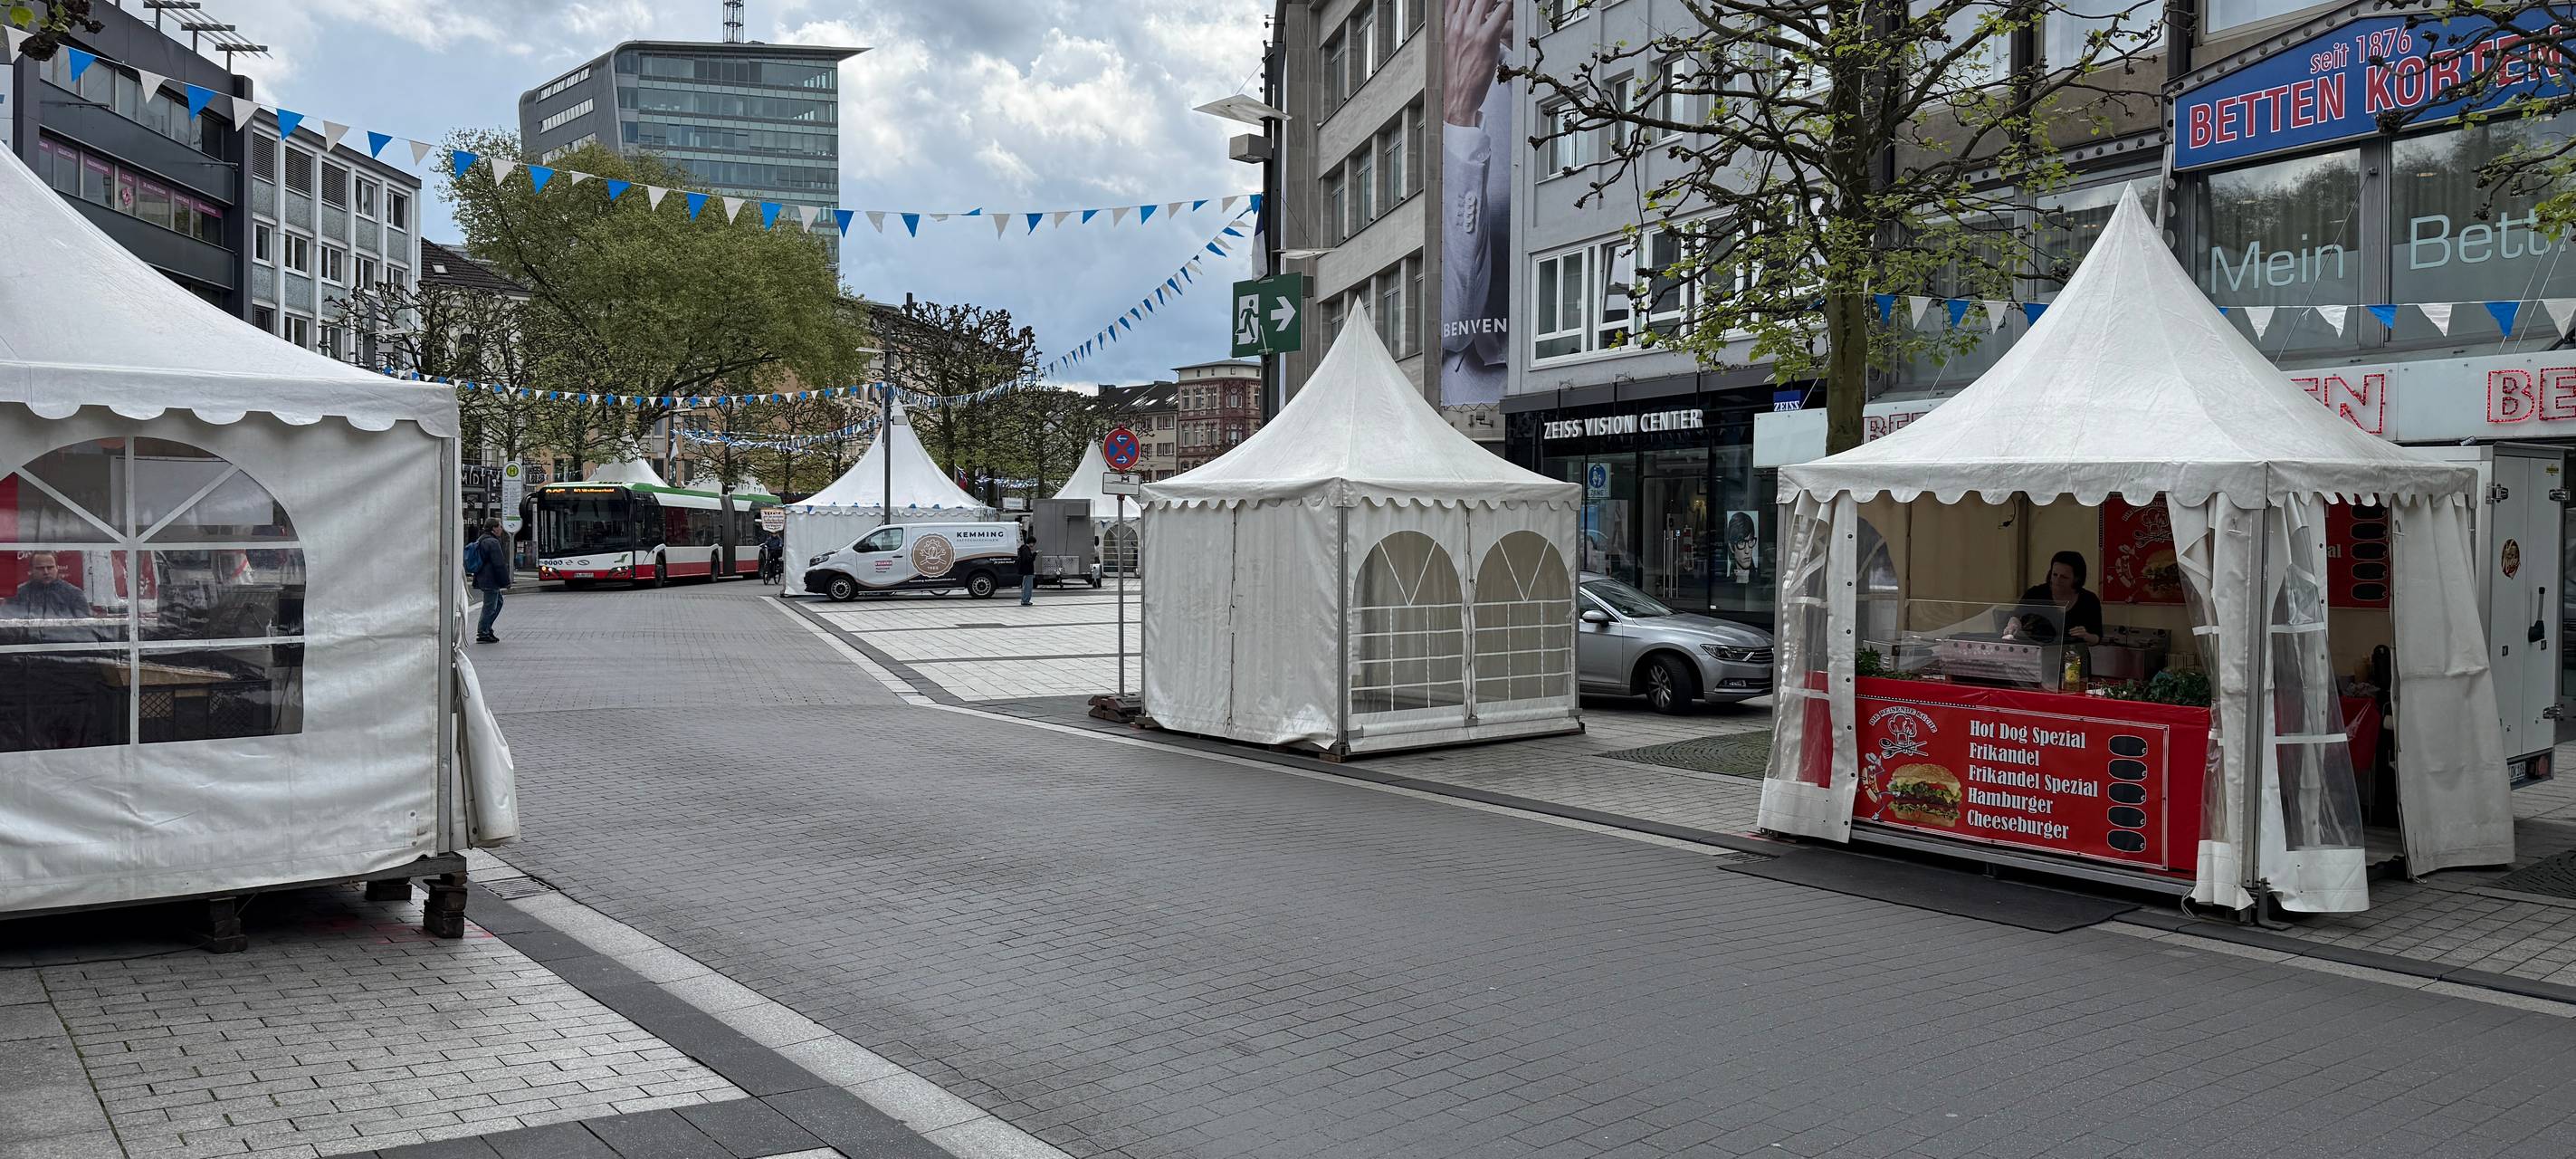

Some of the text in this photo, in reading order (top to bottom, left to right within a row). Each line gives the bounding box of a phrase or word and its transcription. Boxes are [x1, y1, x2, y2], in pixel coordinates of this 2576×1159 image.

[2310, 25, 2412, 74] seit 1876
[2189, 72, 2345, 149] BETTEN
[2210, 234, 2344, 294] Mein
[1443, 318, 1507, 338] BENVEN
[1774, 400, 1800, 412] ZEISS
[1543, 408, 1704, 440] ZEISS VISION CENTER
[1869, 713, 1881, 726] DIE
[1879, 706, 1917, 717] REISENDE
[1970, 720, 2085, 749] Hot Dog Spezial
[1969, 742, 2040, 767] Frikandel
[1968, 764, 2098, 798] Frikandel Spezial
[1968, 787, 2053, 814] Hamburger
[1967, 809, 2069, 839] Cheeseburger
